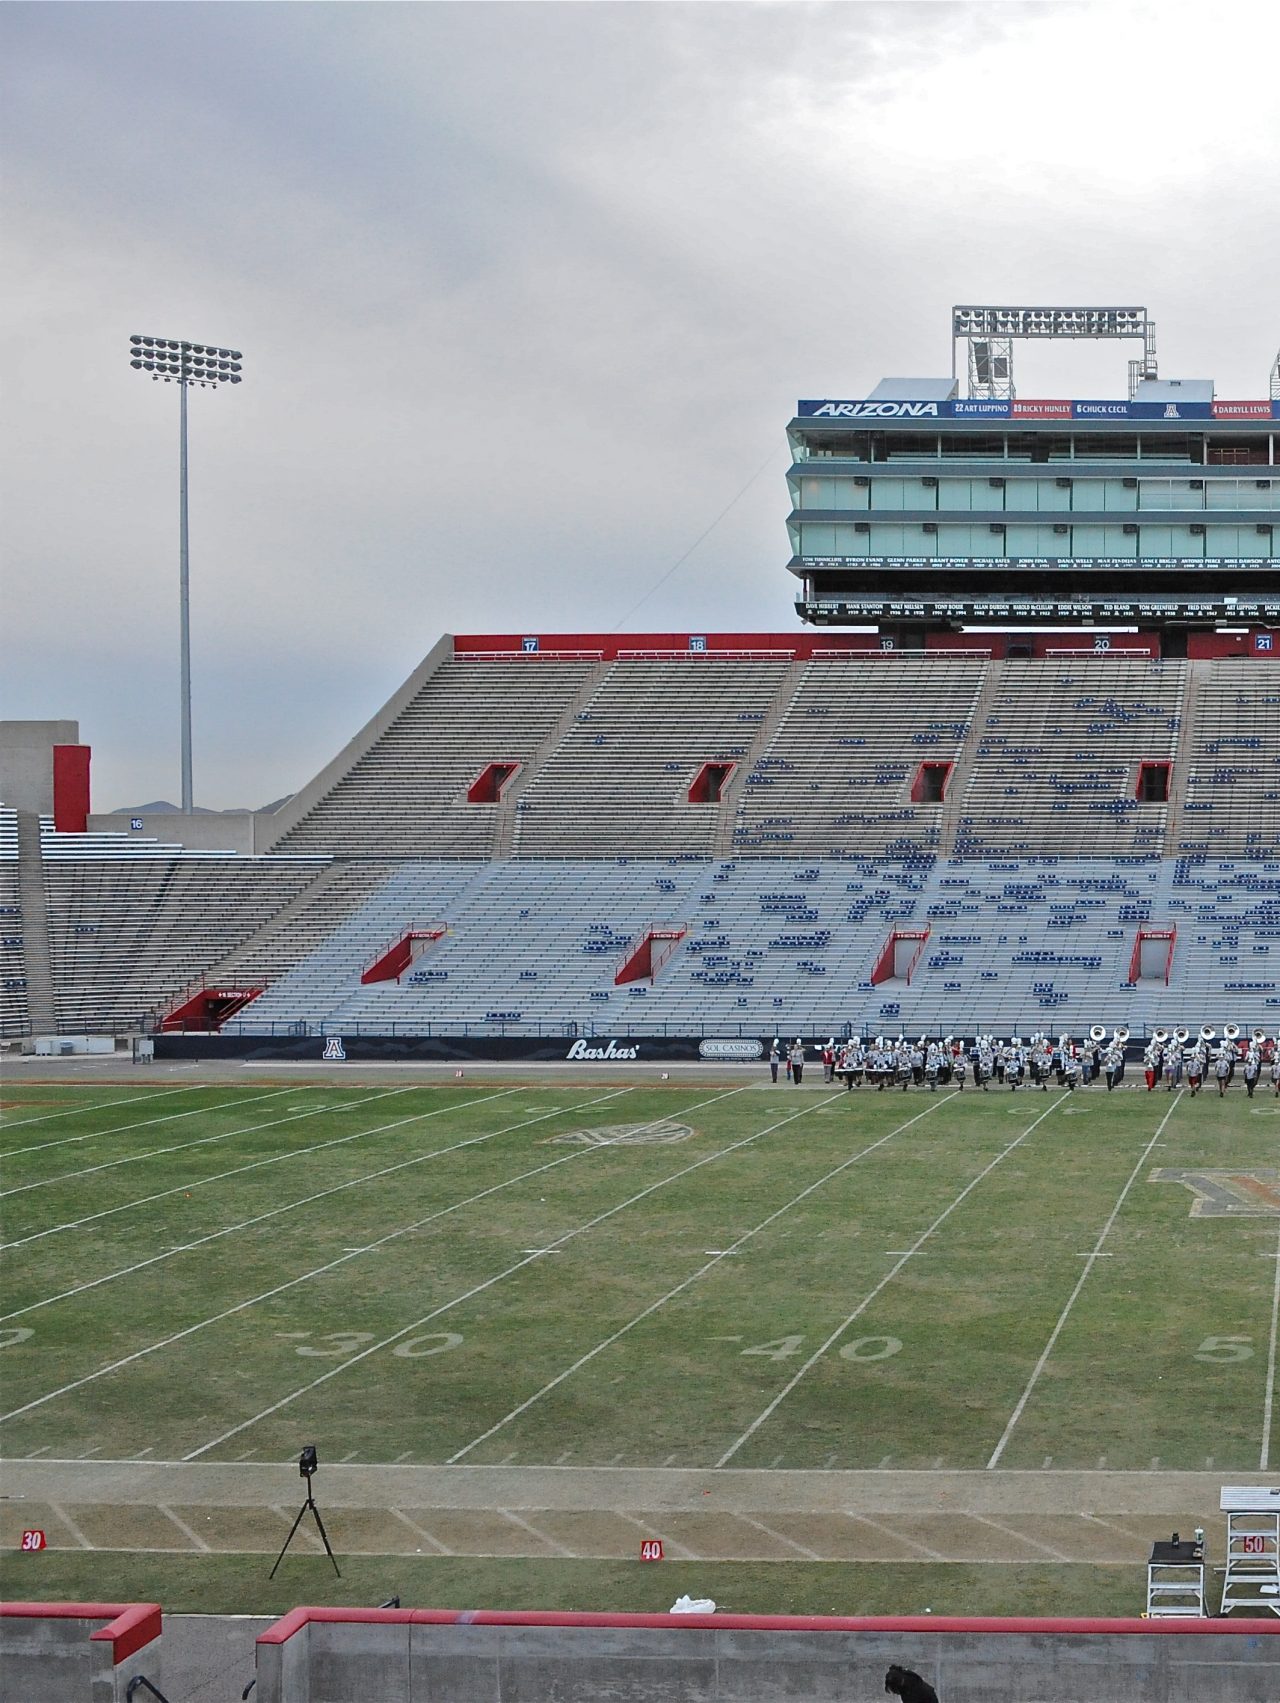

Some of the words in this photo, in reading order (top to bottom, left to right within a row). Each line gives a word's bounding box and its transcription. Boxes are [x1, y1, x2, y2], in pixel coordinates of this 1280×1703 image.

[812, 402, 938, 416] ARIZONA
[955, 403, 964, 412] 22
[964, 404, 977, 412] ART
[979, 404, 1008, 412] LUPPINO
[1013, 403, 1022, 412] 89
[1022, 404, 1042, 412] RICKY
[1045, 404, 1071, 412] HUNLEY
[1077, 404, 1082, 413] 6
[1082, 405, 1106, 413] CHUCK
[1108, 405, 1128, 413] CECIL
[1213, 405, 1218, 413] 4
[1218, 405, 1248, 413] DARRYLL
[1250, 405, 1271, 413] LEWIS
[524, 641, 536, 651] 17
[691, 641, 704, 650] 18
[881, 640, 893, 650] 19
[1095, 640, 1109, 650] 20
[1257, 639, 1270, 649] 21
[131, 819, 143, 829] 16
[323, 1037, 345, 1060] A
[566, 1039, 640, 1060] Bashas'
[706, 1045, 722, 1053] SOL
[724, 1045, 757, 1054] CASINOS
[740, 1335, 904, 1361] 40
[23, 1531, 41, 1550] 30
[1245, 1536, 1263, 1553] 50
[642, 1542, 660, 1559] 40
